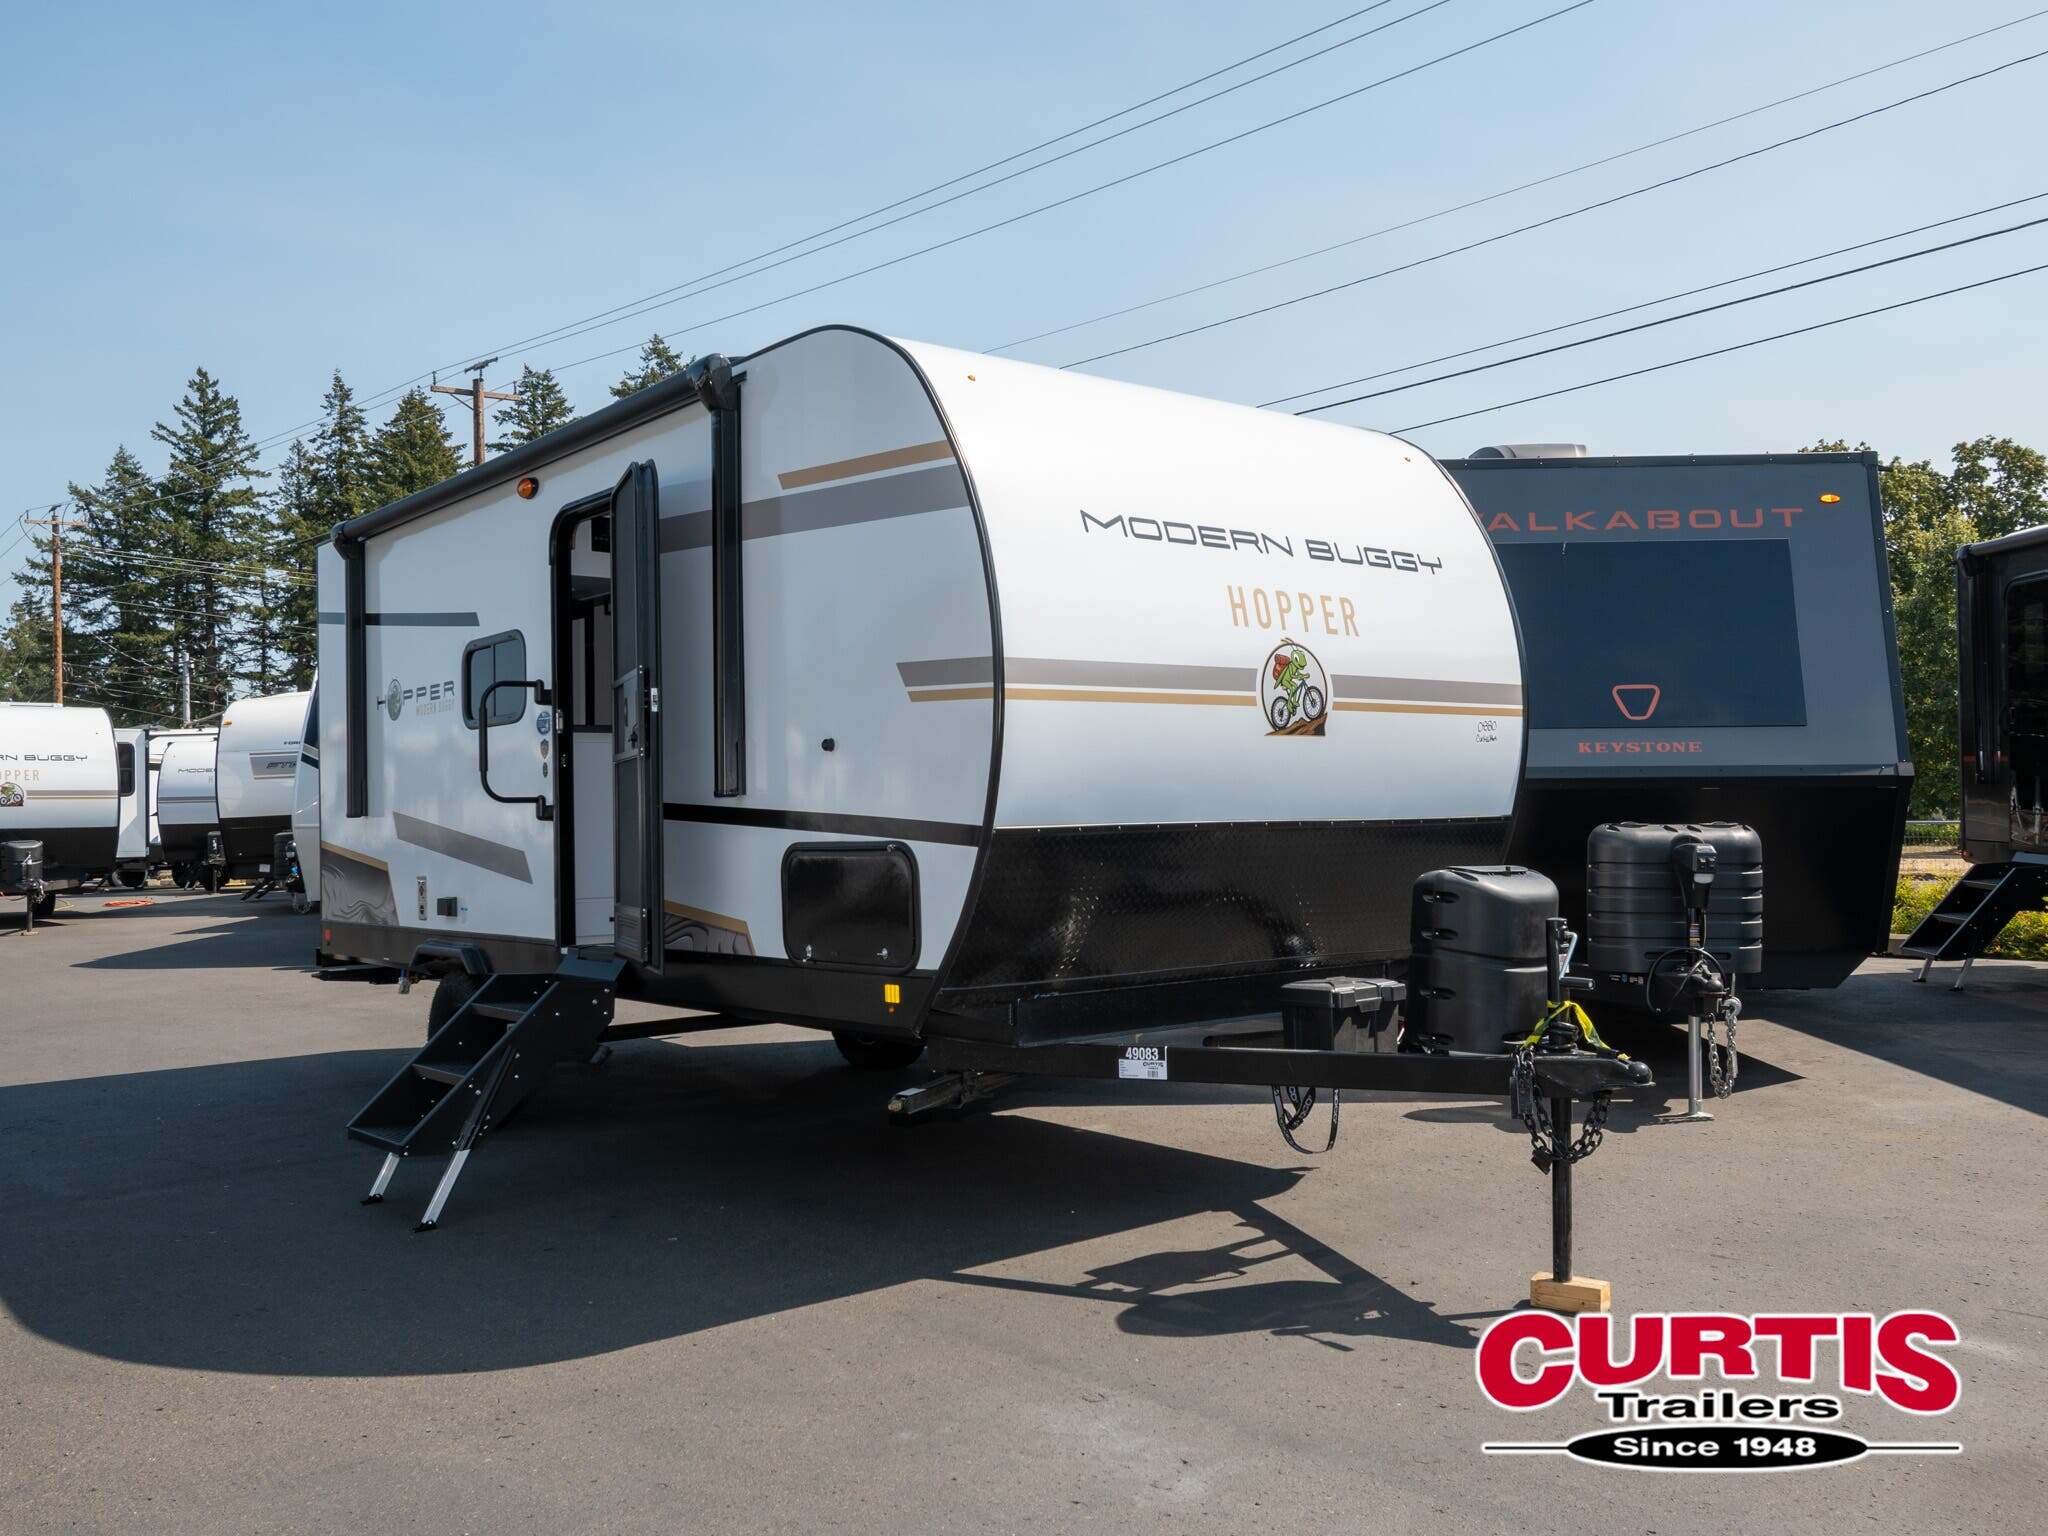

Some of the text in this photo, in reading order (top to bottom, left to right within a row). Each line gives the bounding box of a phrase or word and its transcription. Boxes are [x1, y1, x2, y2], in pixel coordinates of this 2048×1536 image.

[1476, 508, 1804, 532] ALKABOUT
[1080, 509, 1443, 575] MODERN BUGGY
[1227, 584, 1360, 637] HOPPER
[1578, 741, 1703, 754] KEYSTONE
[24, 754, 88, 762] BUGGY
[0, 769, 41, 781] PPER
[1125, 1046, 1159, 1060] 49083
